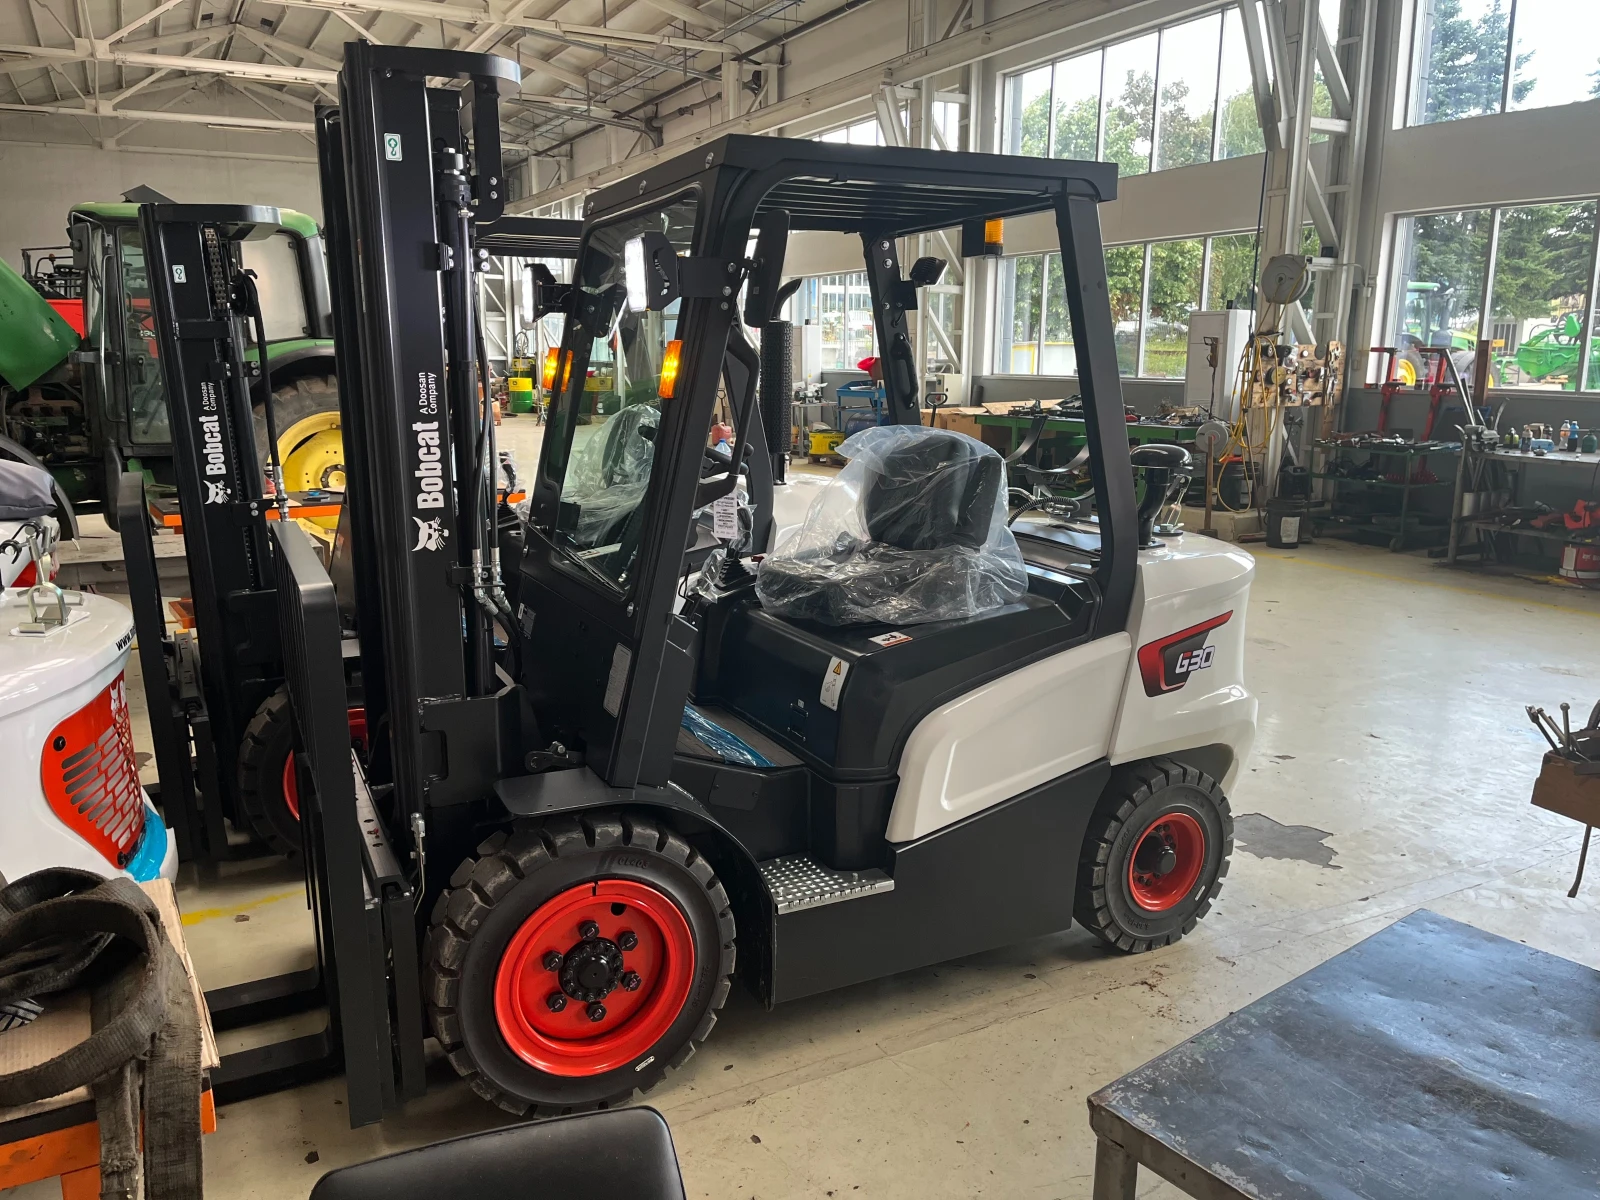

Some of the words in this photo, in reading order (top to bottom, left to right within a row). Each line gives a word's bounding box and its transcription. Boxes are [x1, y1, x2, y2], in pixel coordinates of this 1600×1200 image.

[201, 382, 210, 405] Doosan
[207, 382, 217, 411] Company
[418, 372, 428, 406] Doosan
[428, 372, 438, 415] Company
[420, 406, 429, 415] A
[198, 415, 227, 476] Bobcat
[412, 421, 445, 509] Bobcat
[1175, 645, 1216, 674] G30
